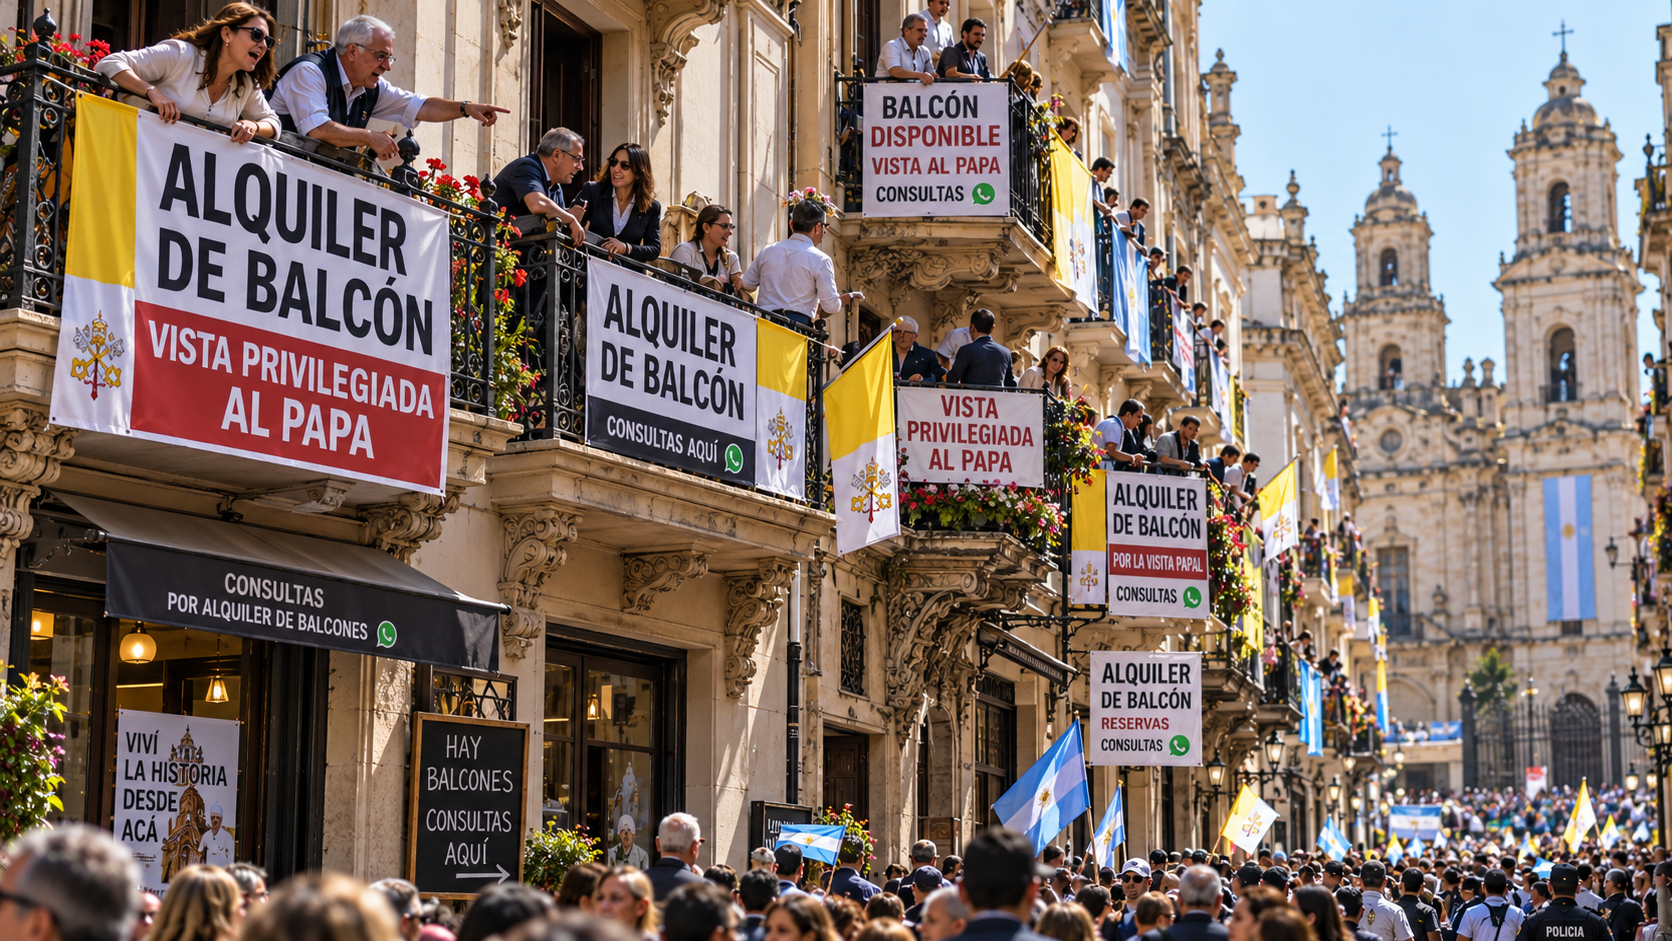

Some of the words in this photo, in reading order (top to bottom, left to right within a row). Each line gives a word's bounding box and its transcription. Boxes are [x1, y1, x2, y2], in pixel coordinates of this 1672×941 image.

[883, 90, 978, 119] BALCÓN
[871, 125, 1001, 147] DISPONIBLE
[872, 157, 922, 175] VISTA
[927, 157, 949, 174] AL
[956, 156, 1001, 174] PAPA
[876, 185, 964, 202] CONSULTAS
[159, 143, 407, 276] ALQUILER
[157, 228, 227, 303] DE
[246, 249, 433, 356] BALCÓN
[603, 283, 736, 367] ALQUILER
[148, 320, 232, 373] VISTA
[242, 342, 435, 420] PRIVILEGIADA
[601, 340, 634, 389] DE
[644, 353, 744, 421] BALCÓN
[940, 394, 999, 420] VISTA
[220, 387, 270, 438] AL
[282, 398, 375, 459] PAPA
[907, 420, 1034, 447] PRIVILEGIADA
[607, 415, 683, 454] CONSULTAS
[687, 438, 718, 463] AQUÍ
[928, 448, 954, 471] AL
[962, 449, 1013, 474] PAPA
[1113, 483, 1198, 511] ALQUILER
[1113, 512, 1133, 535] DE
[1139, 513, 1201, 540] BALCÓN
[1113, 552, 1131, 569] POR
[1133, 554, 1144, 569] LA
[1146, 554, 1175, 571] VISITA
[1176, 556, 1203, 572] PAPAL
[224, 572, 324, 608] CONSULTAS
[1116, 585, 1177, 604] CONSULTAS
[168, 592, 198, 614] POR
[202, 597, 272, 627] ALQUILER
[276, 606, 293, 629] DE
[298, 613, 368, 640] BALCONES
[1102, 662, 1191, 685] ALQUILER
[1101, 691, 1120, 709] DE
[1128, 687, 1191, 709] BALCÓN
[1101, 717, 1170, 730] RESERVAS
[126, 730, 159, 754] VIVÍ
[446, 735, 481, 760] HAY
[1101, 738, 1163, 752] CONSULTAS
[124, 759, 146, 781] LA
[151, 761, 228, 786] HISTORIA
[426, 767, 513, 793] BALCONES
[123, 788, 178, 812] DESDE
[121, 815, 158, 842] ACÁ
[426, 808, 512, 833] CONSULTAS
[444, 838, 487, 867] AQUÍ
[1546, 925, 1584, 938] POLICIA
